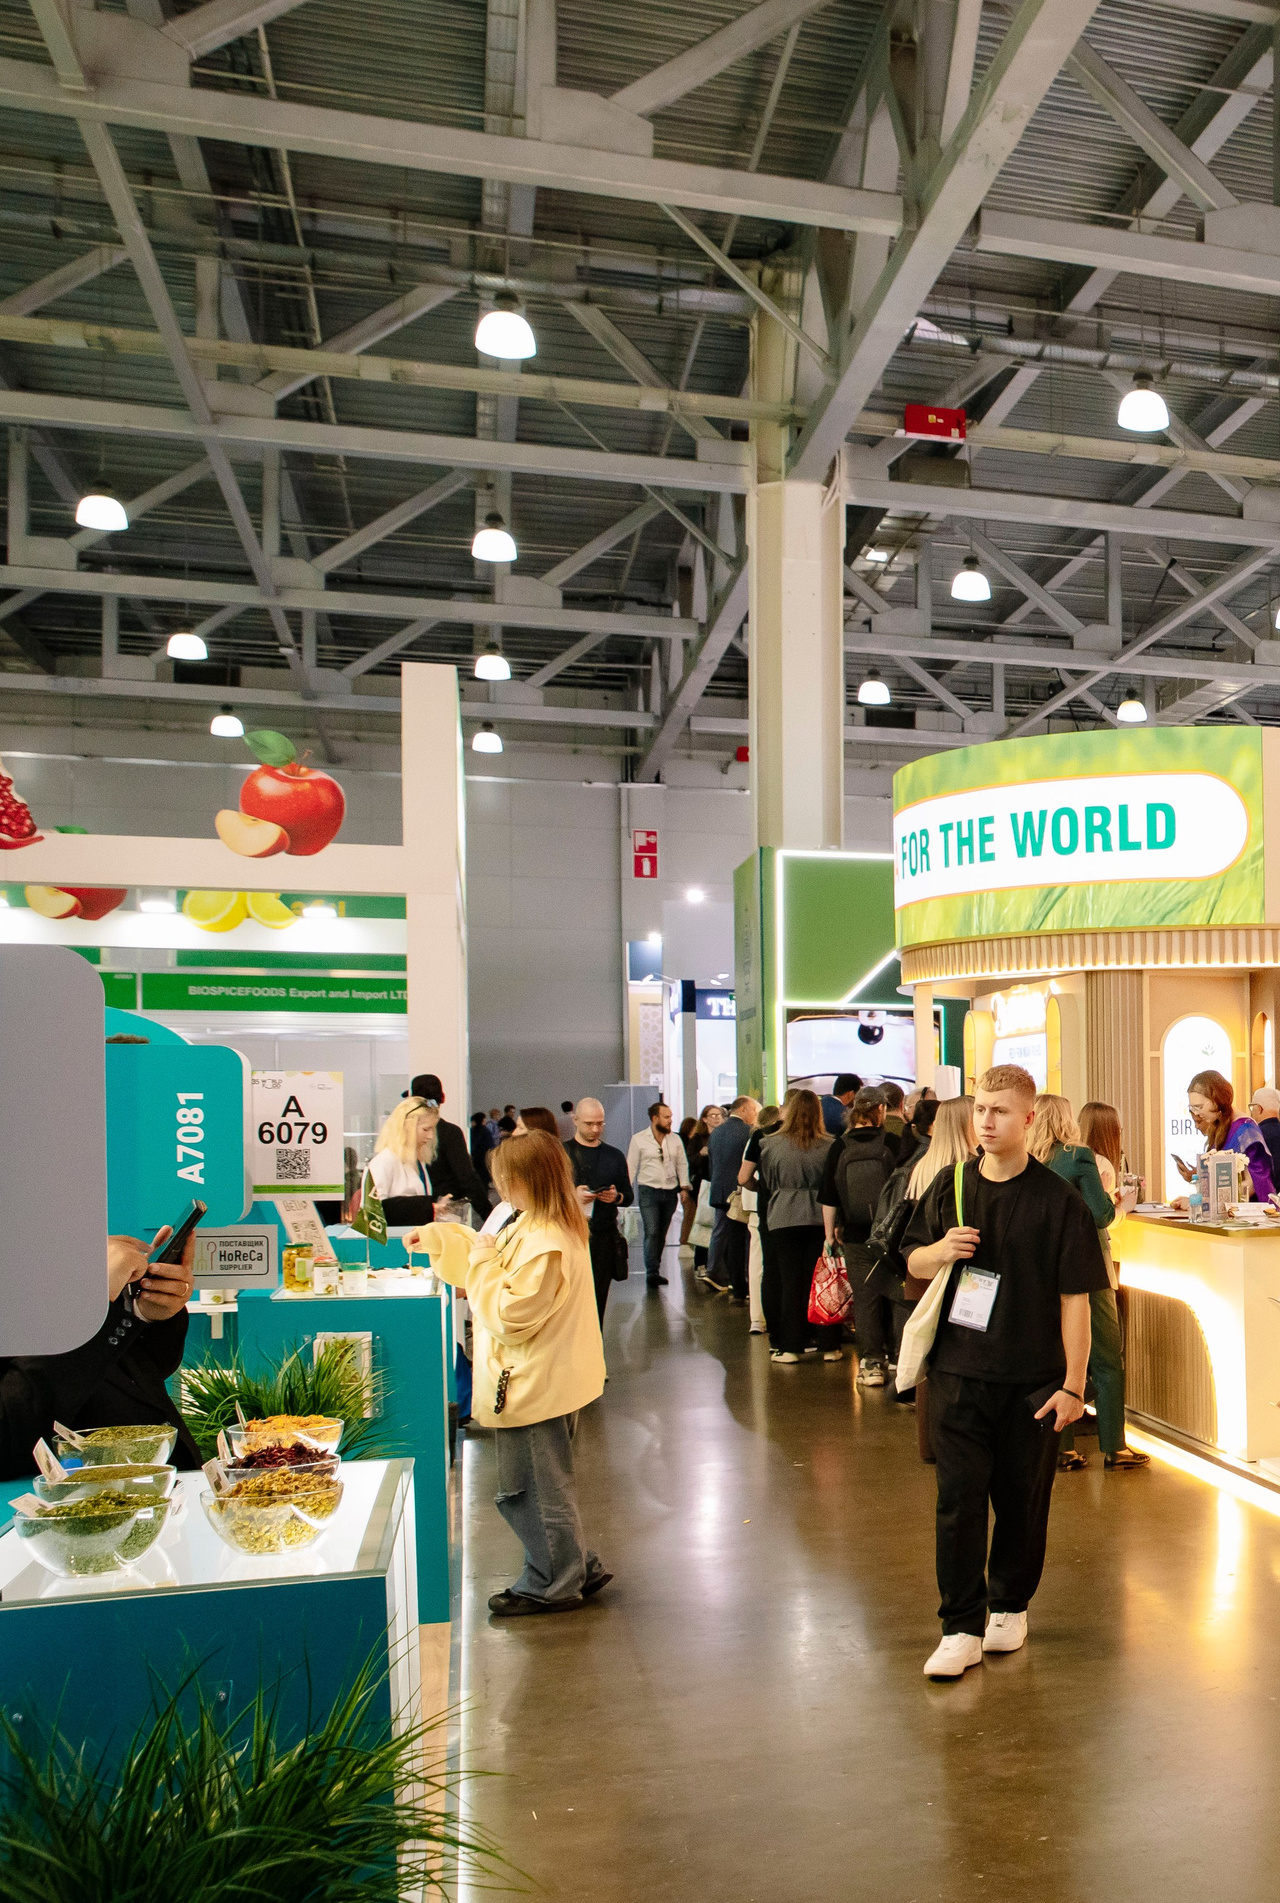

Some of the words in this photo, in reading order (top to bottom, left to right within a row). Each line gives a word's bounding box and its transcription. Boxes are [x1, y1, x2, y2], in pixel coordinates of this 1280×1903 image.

[901, 828, 930, 879] FOR
[939, 816, 995, 868] THE
[1010, 802, 1176, 858] WORLD
[188, 985, 287, 997] BIOSPICEFOODS
[289, 987, 327, 999] Export
[328, 989, 350, 998] and
[351, 989, 388, 1001] Import
[281, 1095, 305, 1117] A
[176, 1093, 204, 1184] A7081
[258, 1122, 328, 1144] 6079
[219, 1250, 263, 1262] HoReCa
